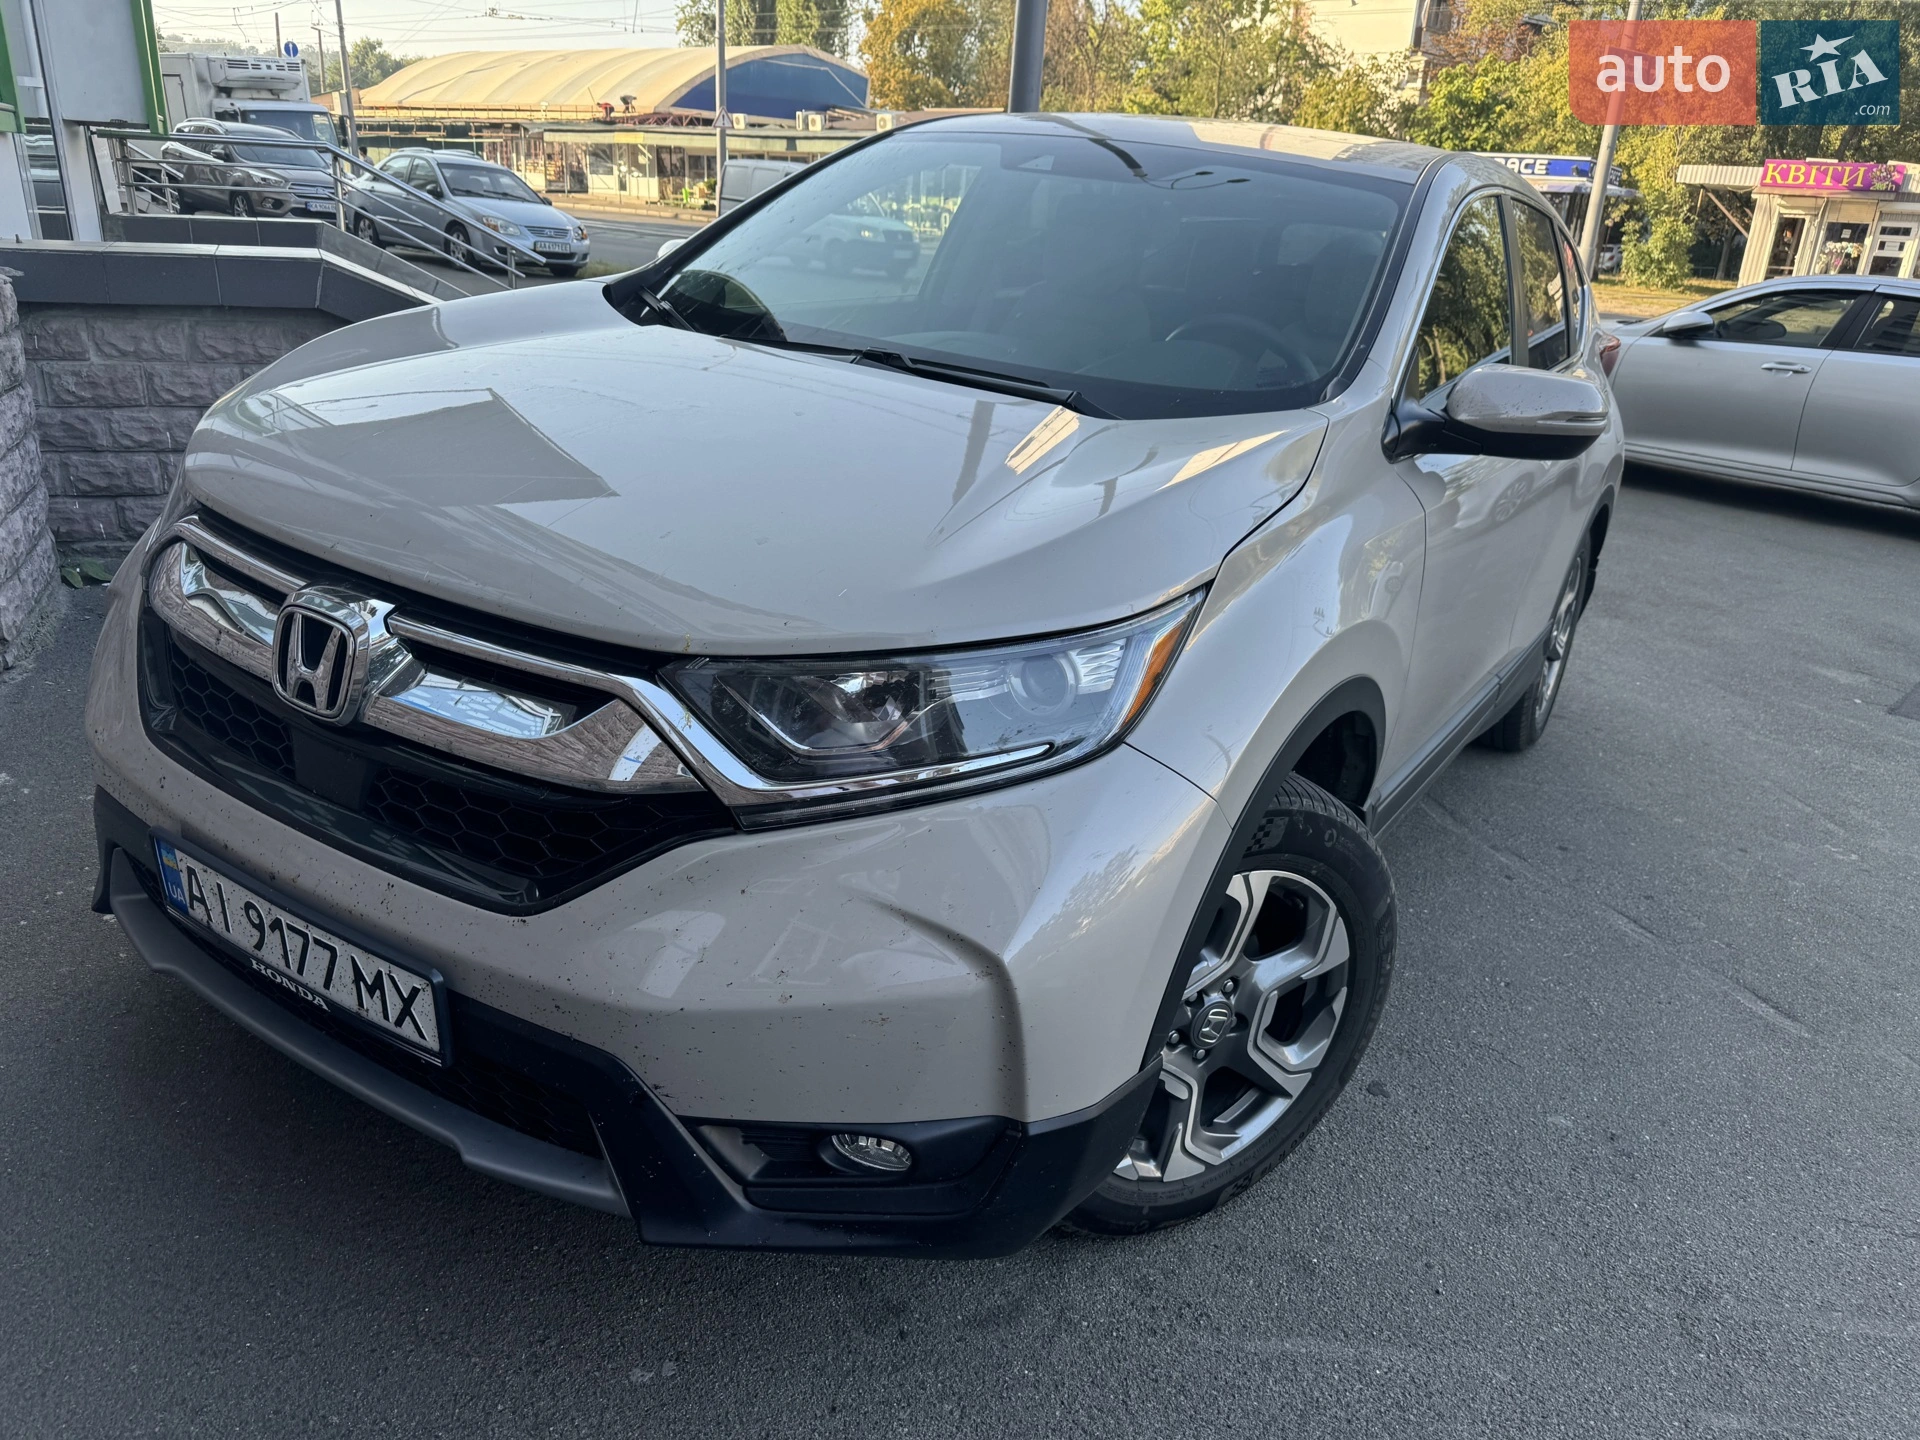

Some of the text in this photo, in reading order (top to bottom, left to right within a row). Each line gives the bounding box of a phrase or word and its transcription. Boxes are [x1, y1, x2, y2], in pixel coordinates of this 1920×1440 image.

[1762, 163, 1868, 188] КВІТИ
[170, 884, 187, 905] UA
[186, 863, 429, 1041] AI 9177 MX
[249, 958, 331, 1013] HONDA
